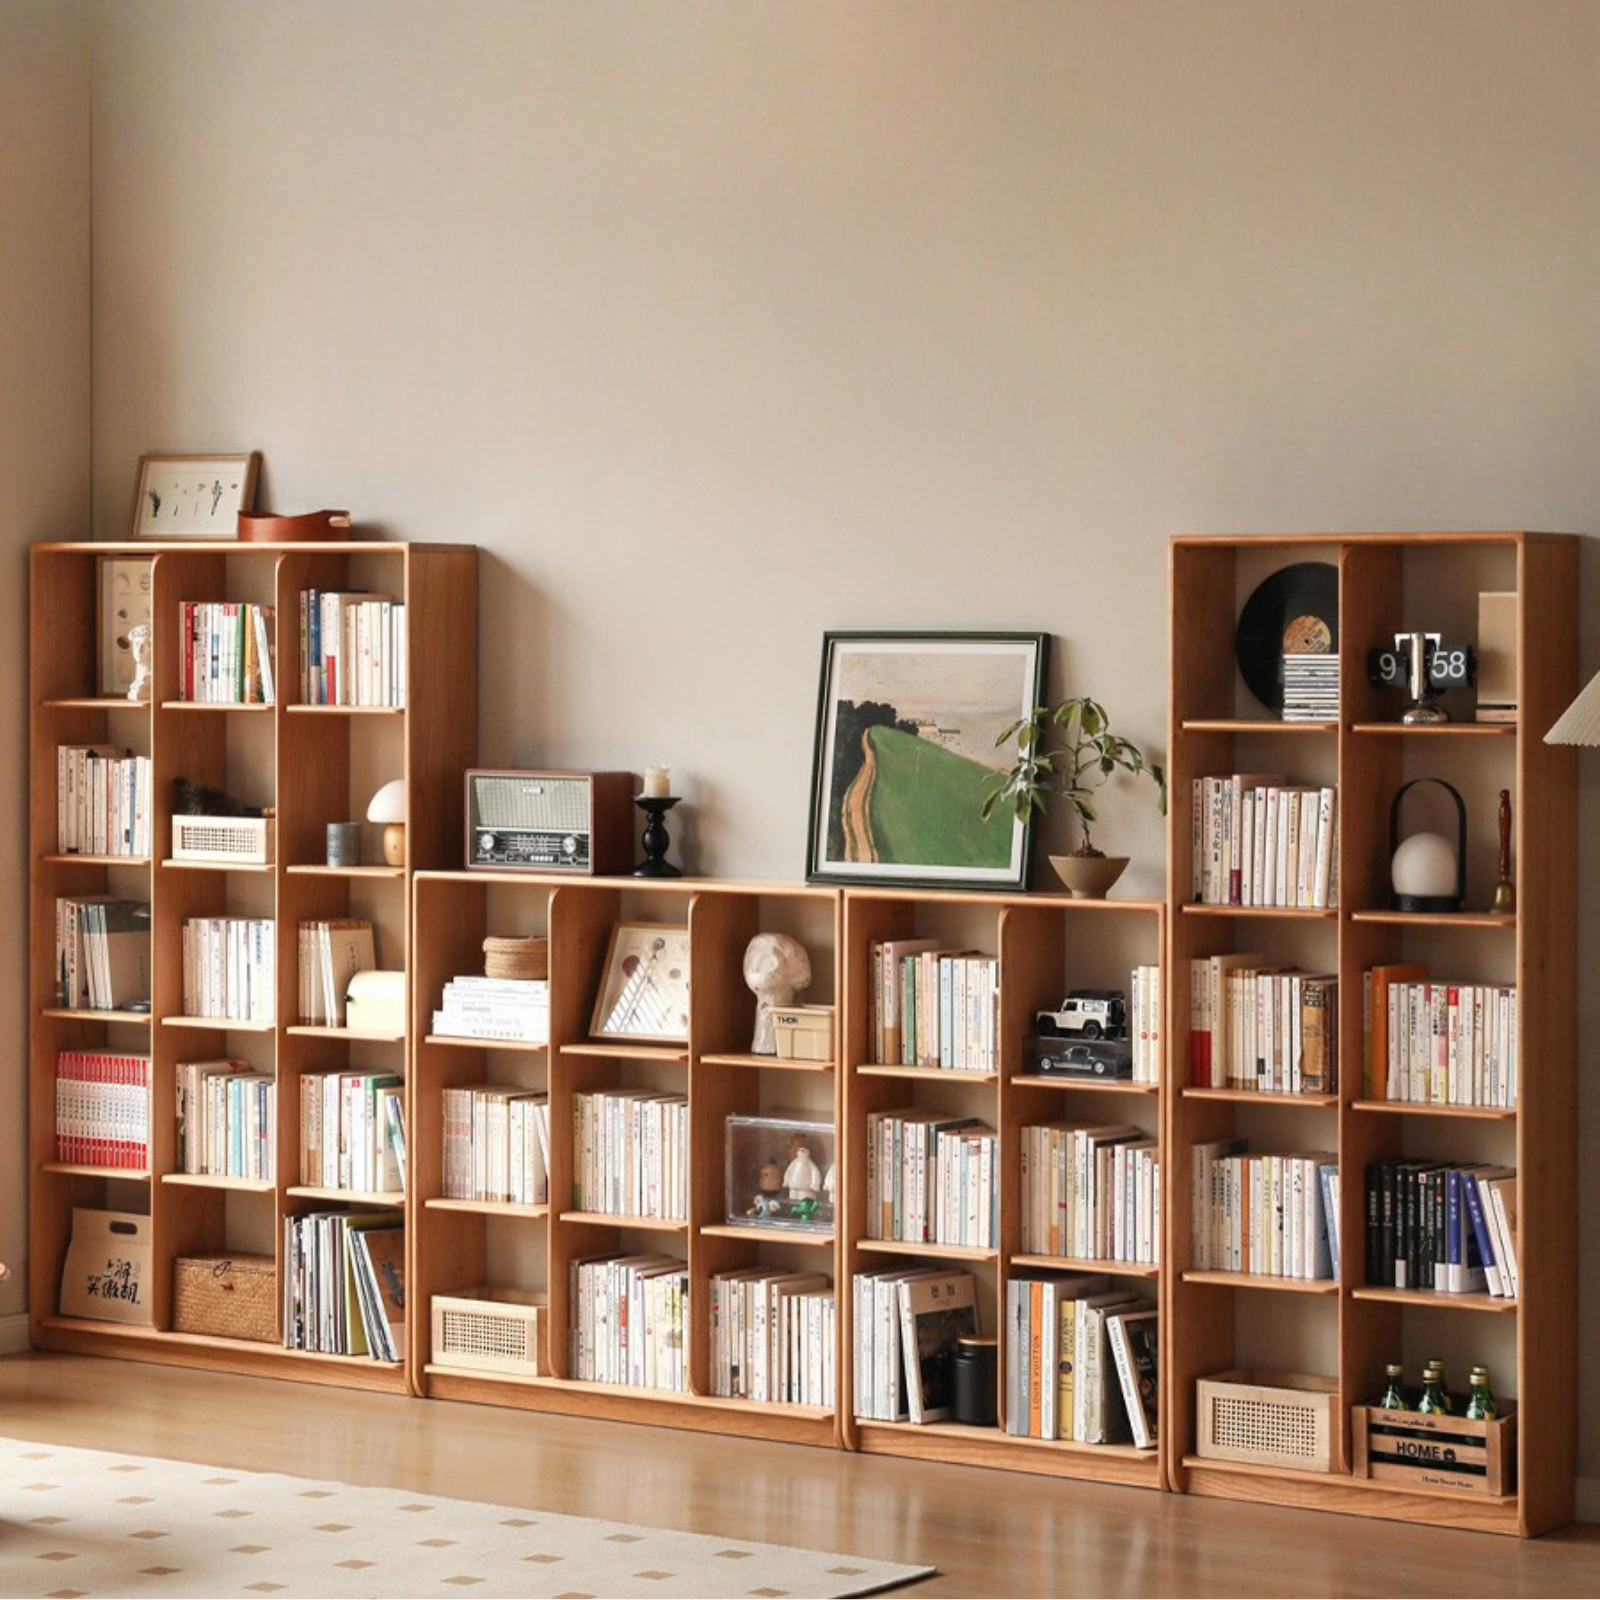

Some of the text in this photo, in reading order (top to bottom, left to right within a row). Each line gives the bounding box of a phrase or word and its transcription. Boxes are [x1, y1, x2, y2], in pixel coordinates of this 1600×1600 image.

[1379, 651, 1466, 680] 9 58
[1396, 1441, 1440, 1459] HOME
